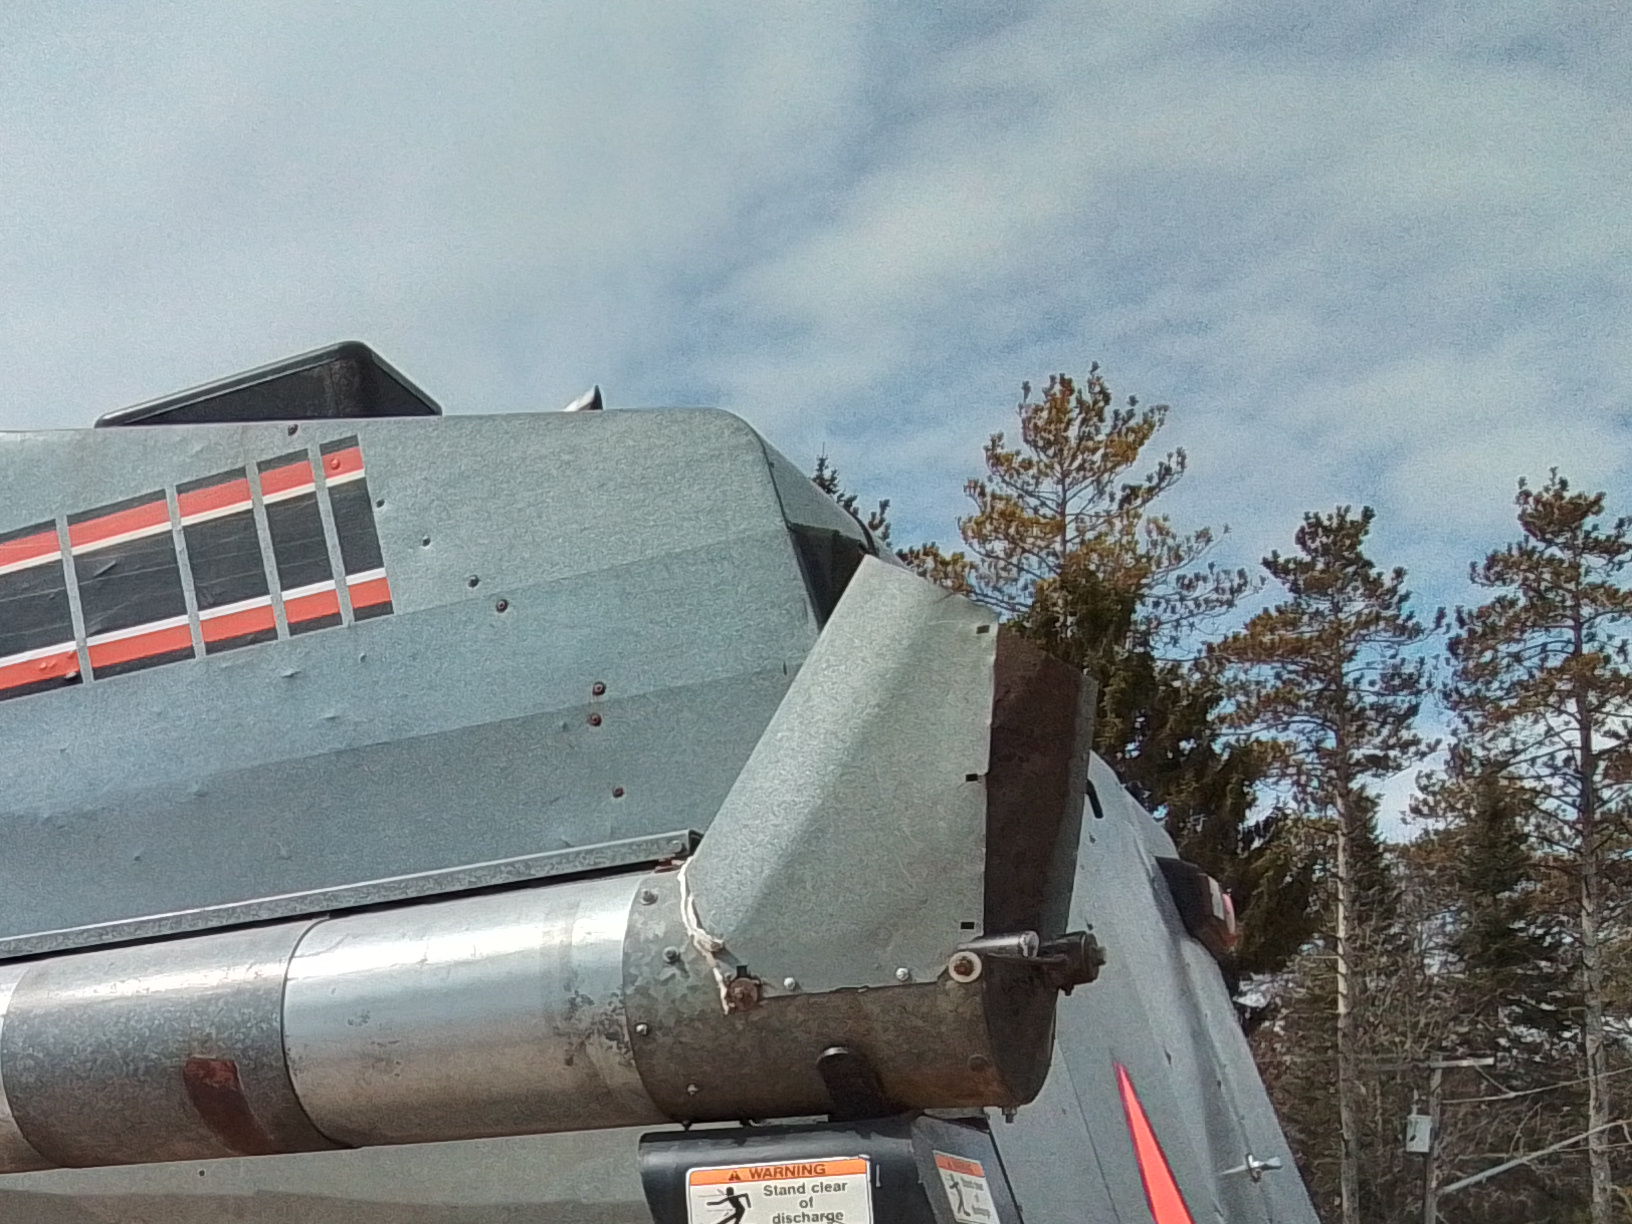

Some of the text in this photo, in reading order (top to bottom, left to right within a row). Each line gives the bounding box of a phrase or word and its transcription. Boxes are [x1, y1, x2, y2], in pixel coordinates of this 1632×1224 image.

[748, 1163, 826, 1180] WARNING
[763, 1181, 848, 1197] Stand clear
[798, 1196, 814, 1209] of
[772, 1210, 844, 1224] discharge
